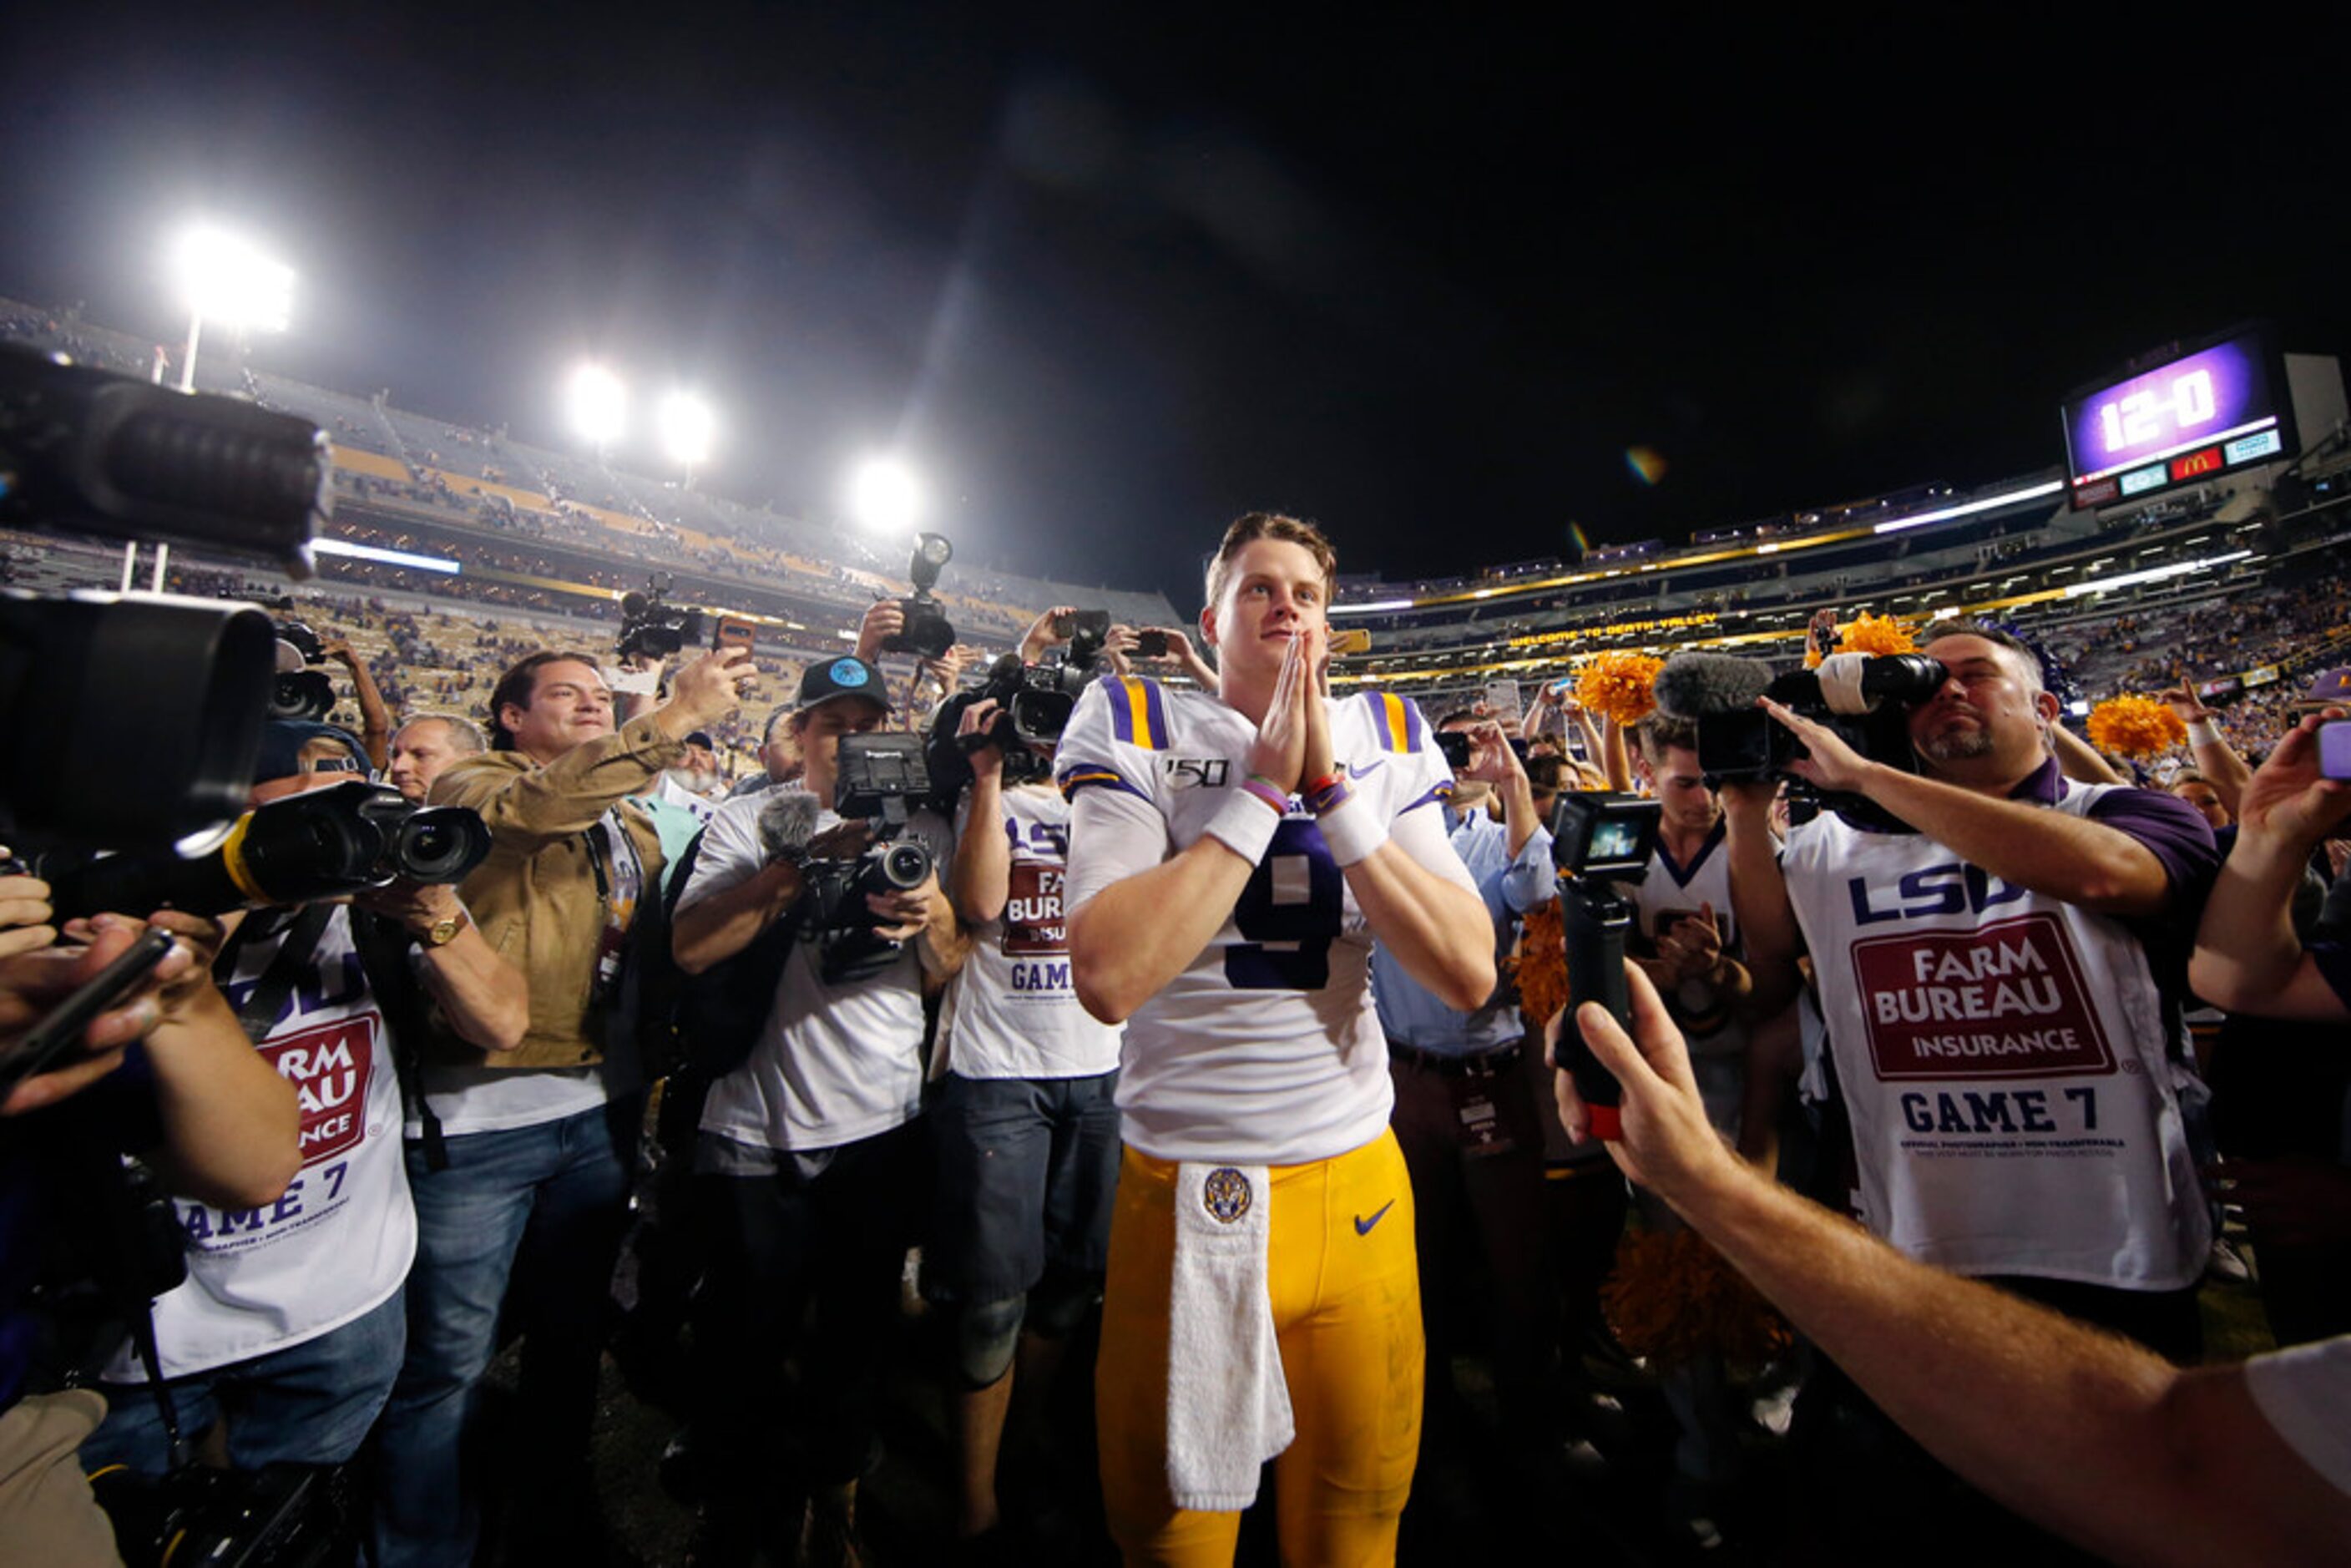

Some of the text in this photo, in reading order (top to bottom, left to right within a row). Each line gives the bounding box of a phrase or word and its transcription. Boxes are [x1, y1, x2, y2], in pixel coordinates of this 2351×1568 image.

[2100, 369, 2217, 453] 12-0
[1509, 613, 1717, 647] WELCOME TO DEATH VALLEY
[1039, 872, 1066, 894] FA
[1224, 817, 1344, 989] 9
[1009, 898, 1066, 922] BUR
[1011, 963, 1075, 991] GAM
[1913, 936, 2048, 983] FARM
[1874, 976, 2062, 1024] BUREAU
[277, 1036, 355, 1080] RM
[1911, 1028, 2081, 1058] INSURANCE
[1900, 1087, 2097, 1133] GAME 7
[185, 1179, 305, 1242] AME
[323, 1161, 348, 1201] 7
